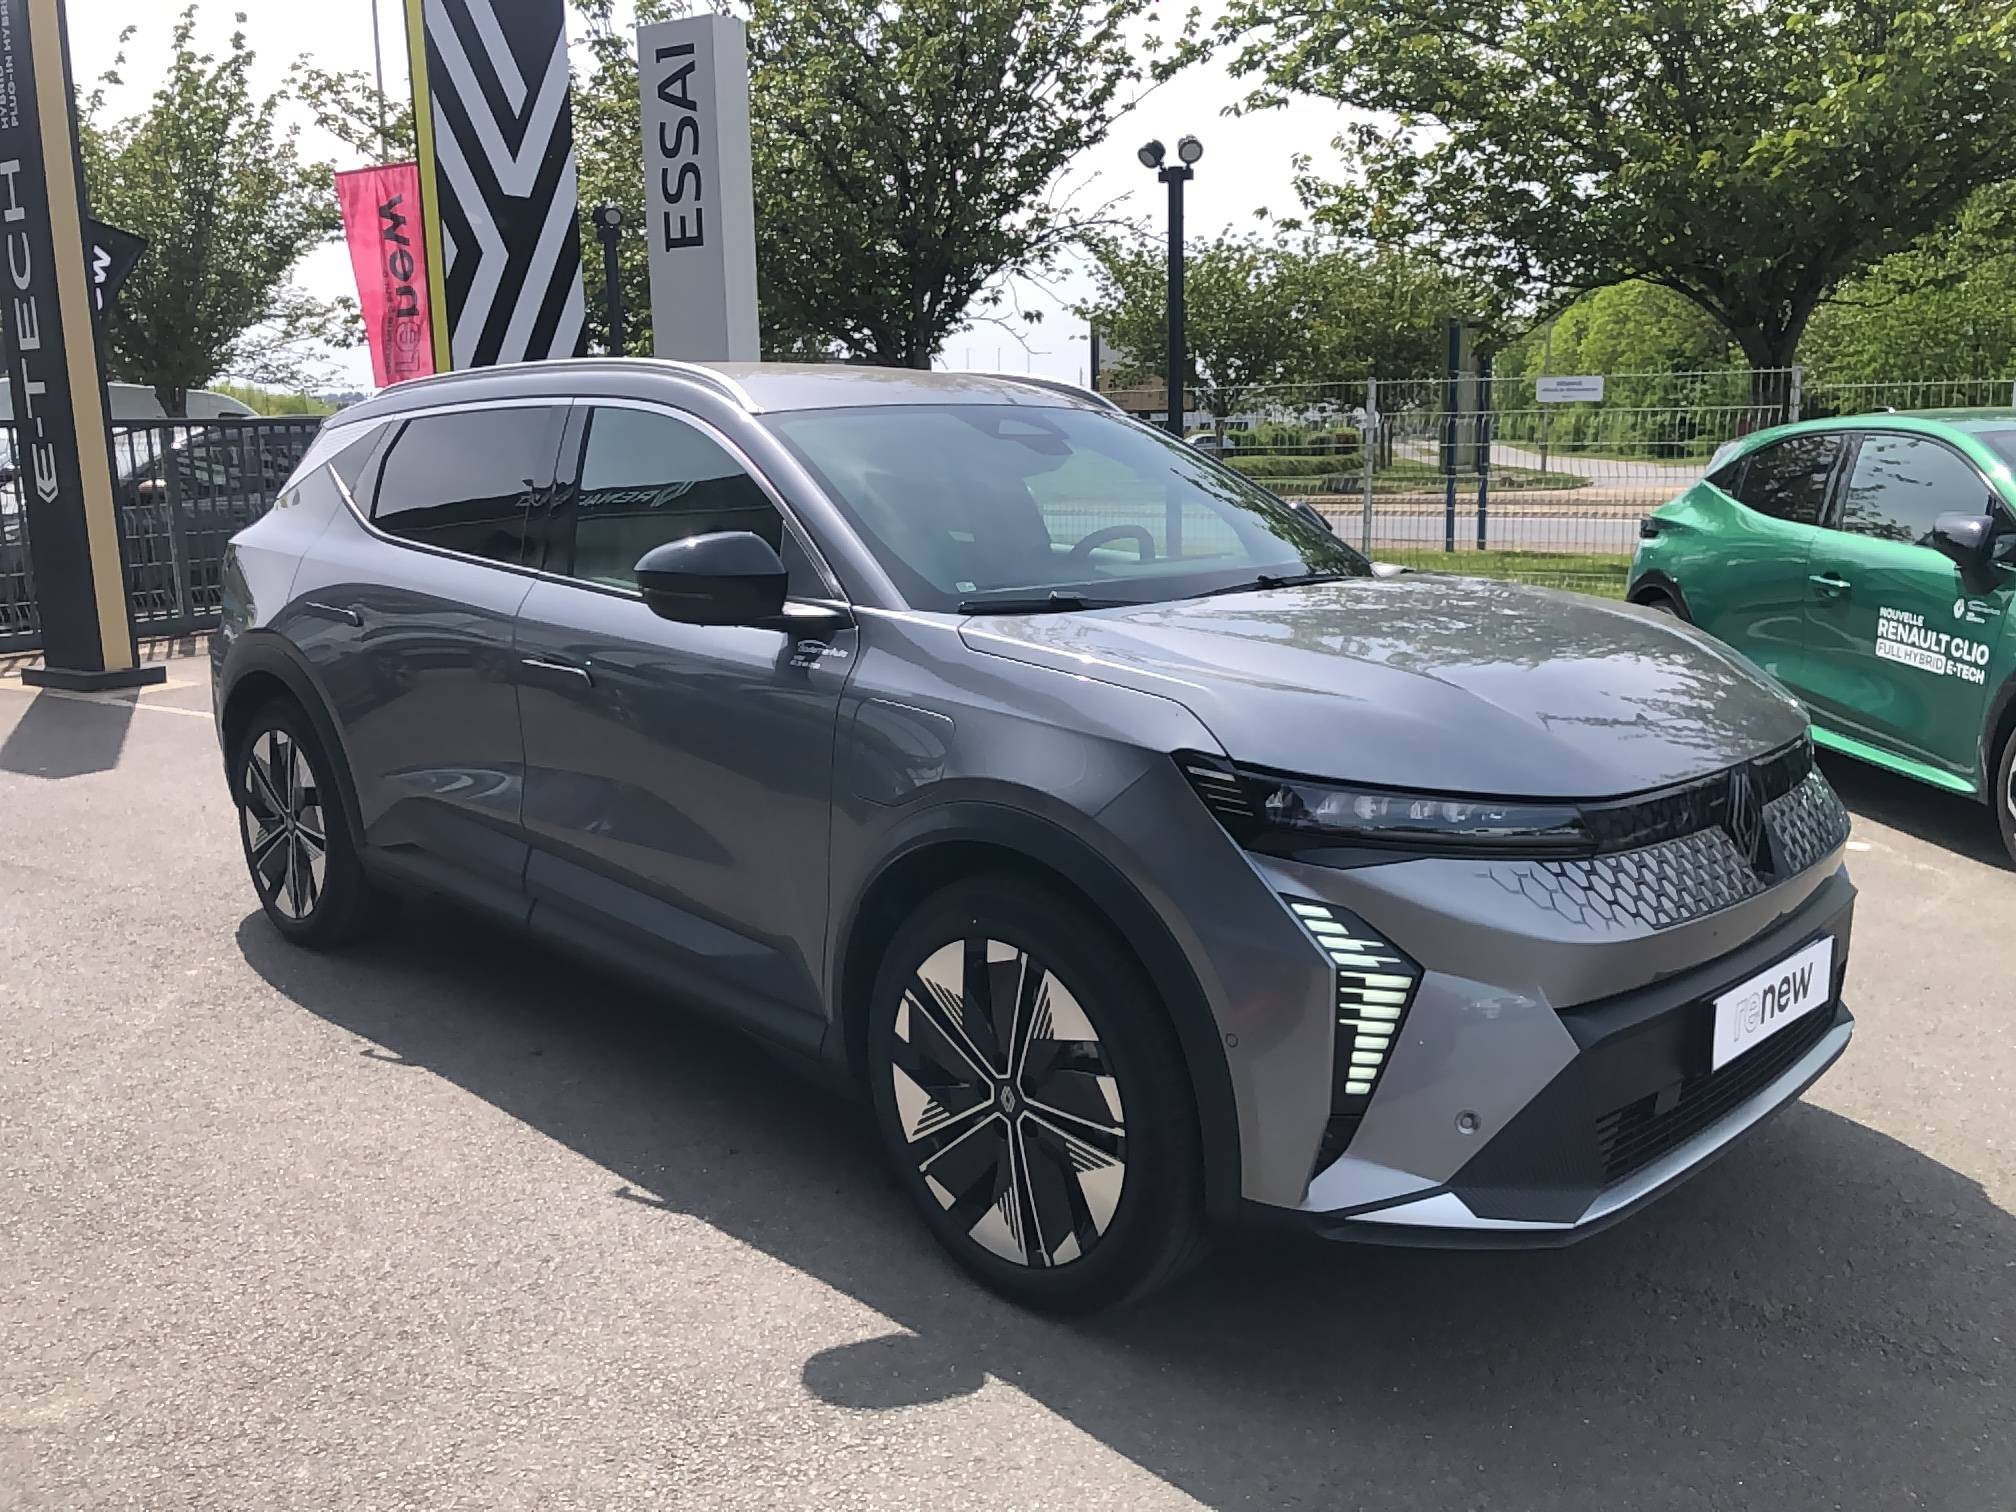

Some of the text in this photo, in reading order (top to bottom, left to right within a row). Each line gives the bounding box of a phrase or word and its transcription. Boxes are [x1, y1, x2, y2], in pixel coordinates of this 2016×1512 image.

[655, 42, 705, 252] ESSAI
[0, 158, 58, 503] E-TECH
[1877, 618, 1989, 666] RENAULT CLIO
[1879, 606, 1924, 627] NOUVELLE
[1878, 641, 1985, 684] FULL HYBRID E-TECH
[1734, 961, 1813, 1042] renew
